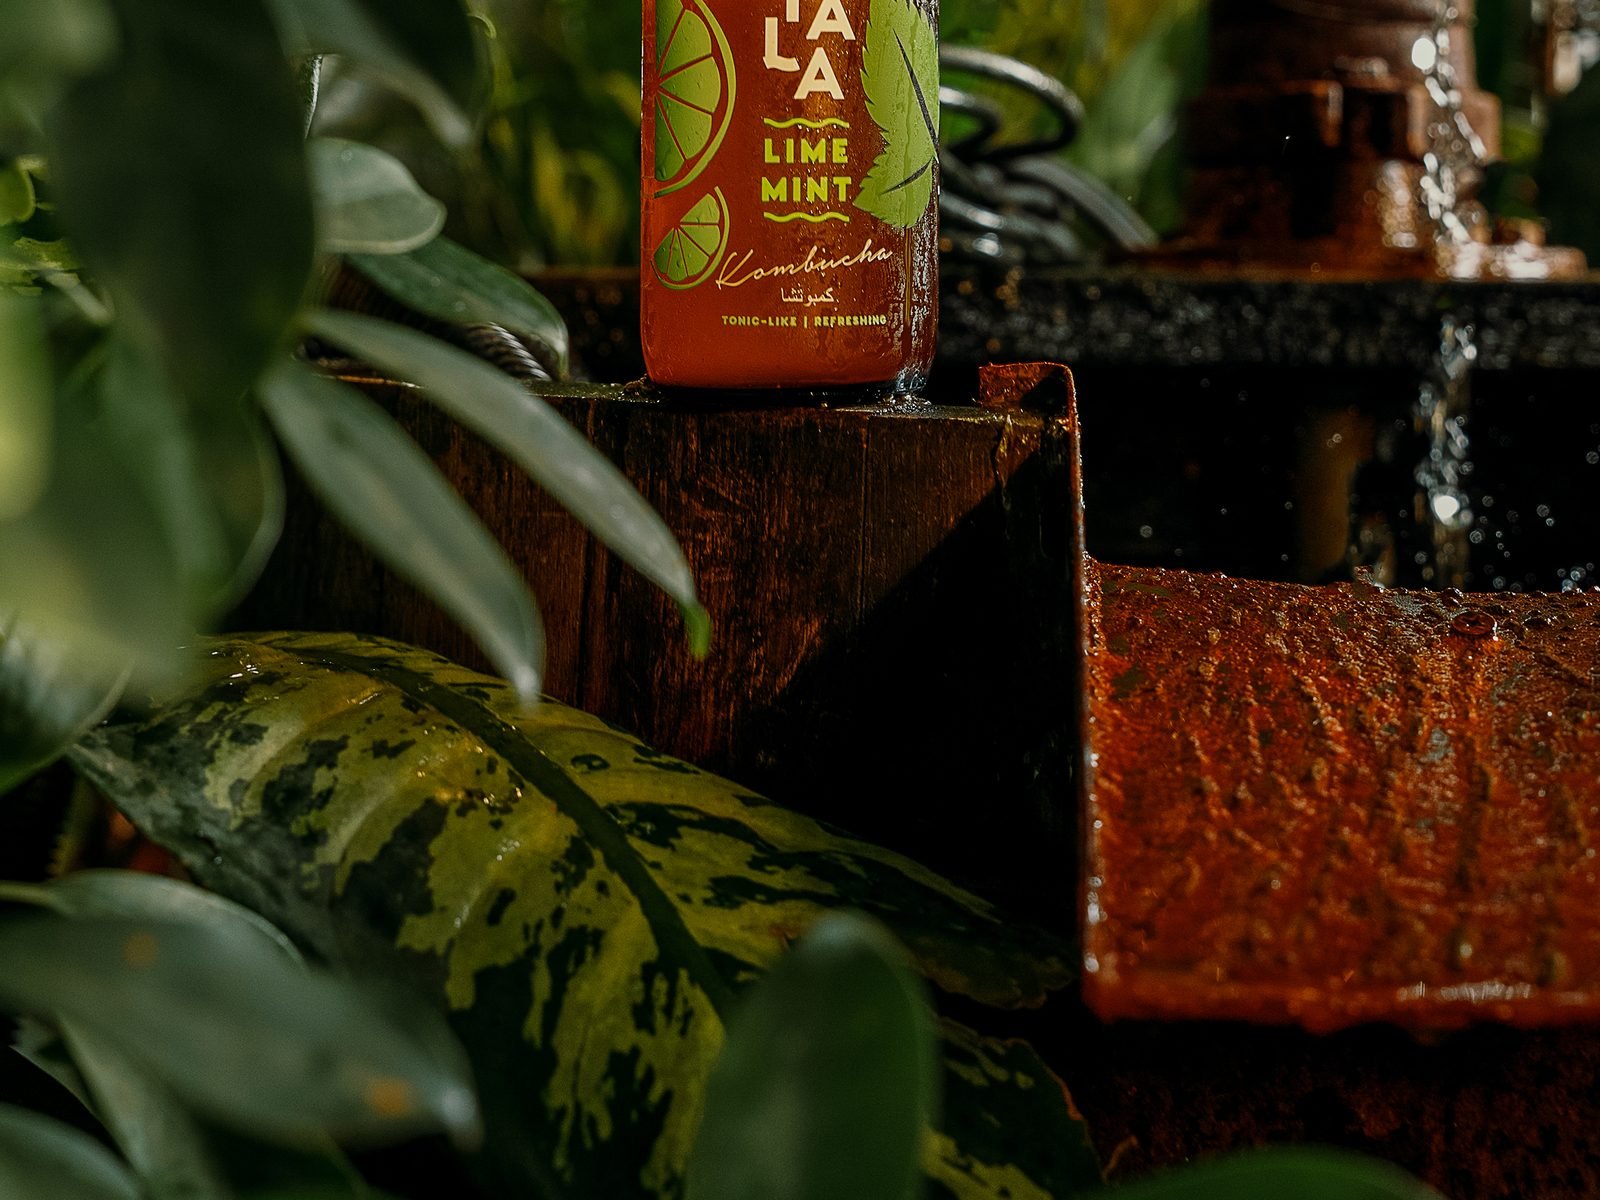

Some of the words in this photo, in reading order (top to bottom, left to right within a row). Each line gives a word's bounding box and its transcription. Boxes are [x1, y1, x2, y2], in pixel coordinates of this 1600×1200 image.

[764, 138, 848, 164] LIME
[761, 176, 852, 202] MINT
[715, 238, 893, 291] Kombucha
[721, 315, 798, 327] TONIC-LIKE
[814, 314, 888, 327] REFRESHING
